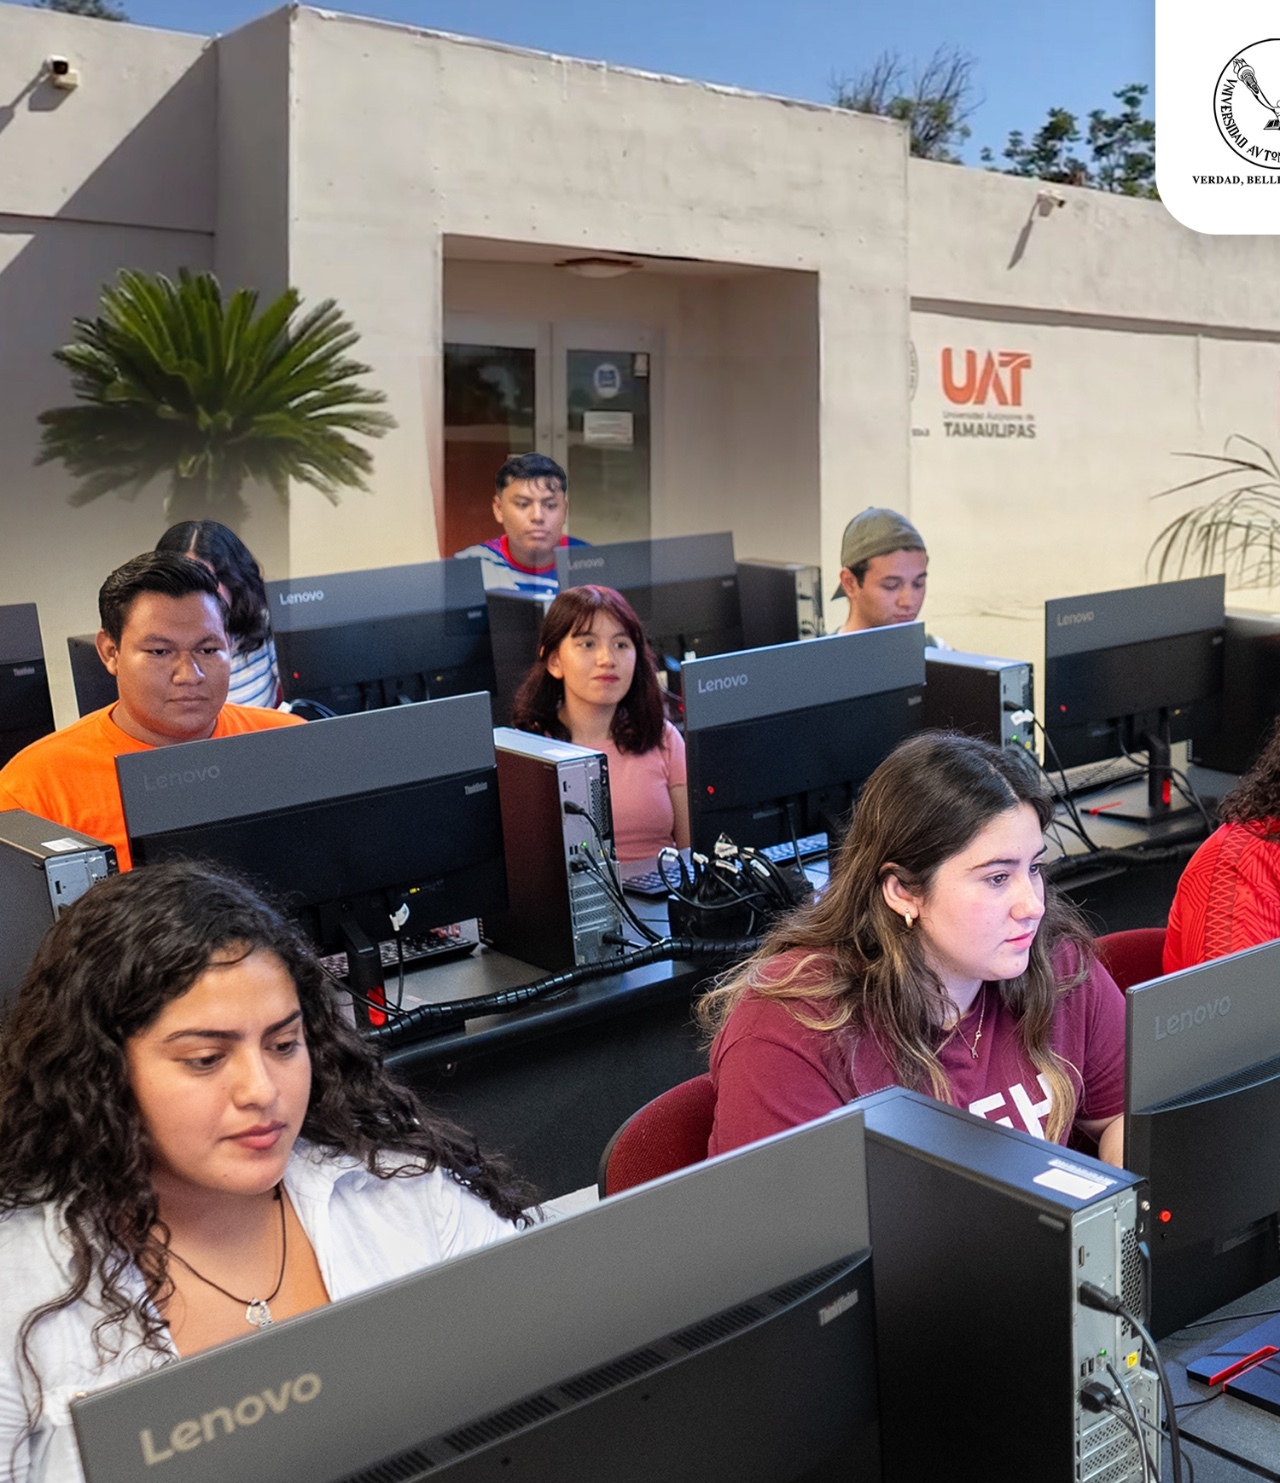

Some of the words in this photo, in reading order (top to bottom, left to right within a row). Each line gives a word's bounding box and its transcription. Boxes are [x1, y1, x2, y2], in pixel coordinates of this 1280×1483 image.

[941, 347, 1032, 406] UAT
[943, 421, 1037, 439] TAMAULIPAS
[568, 555, 605, 571] Lenovo
[279, 588, 325, 606] Lenovo
[1056, 610, 1096, 627] Lenovo
[697, 672, 749, 694] Lenovo
[143, 764, 221, 793] Lenovo
[1154, 996, 1232, 1042] Lenovo
[138, 1371, 323, 1466] Lenovo
